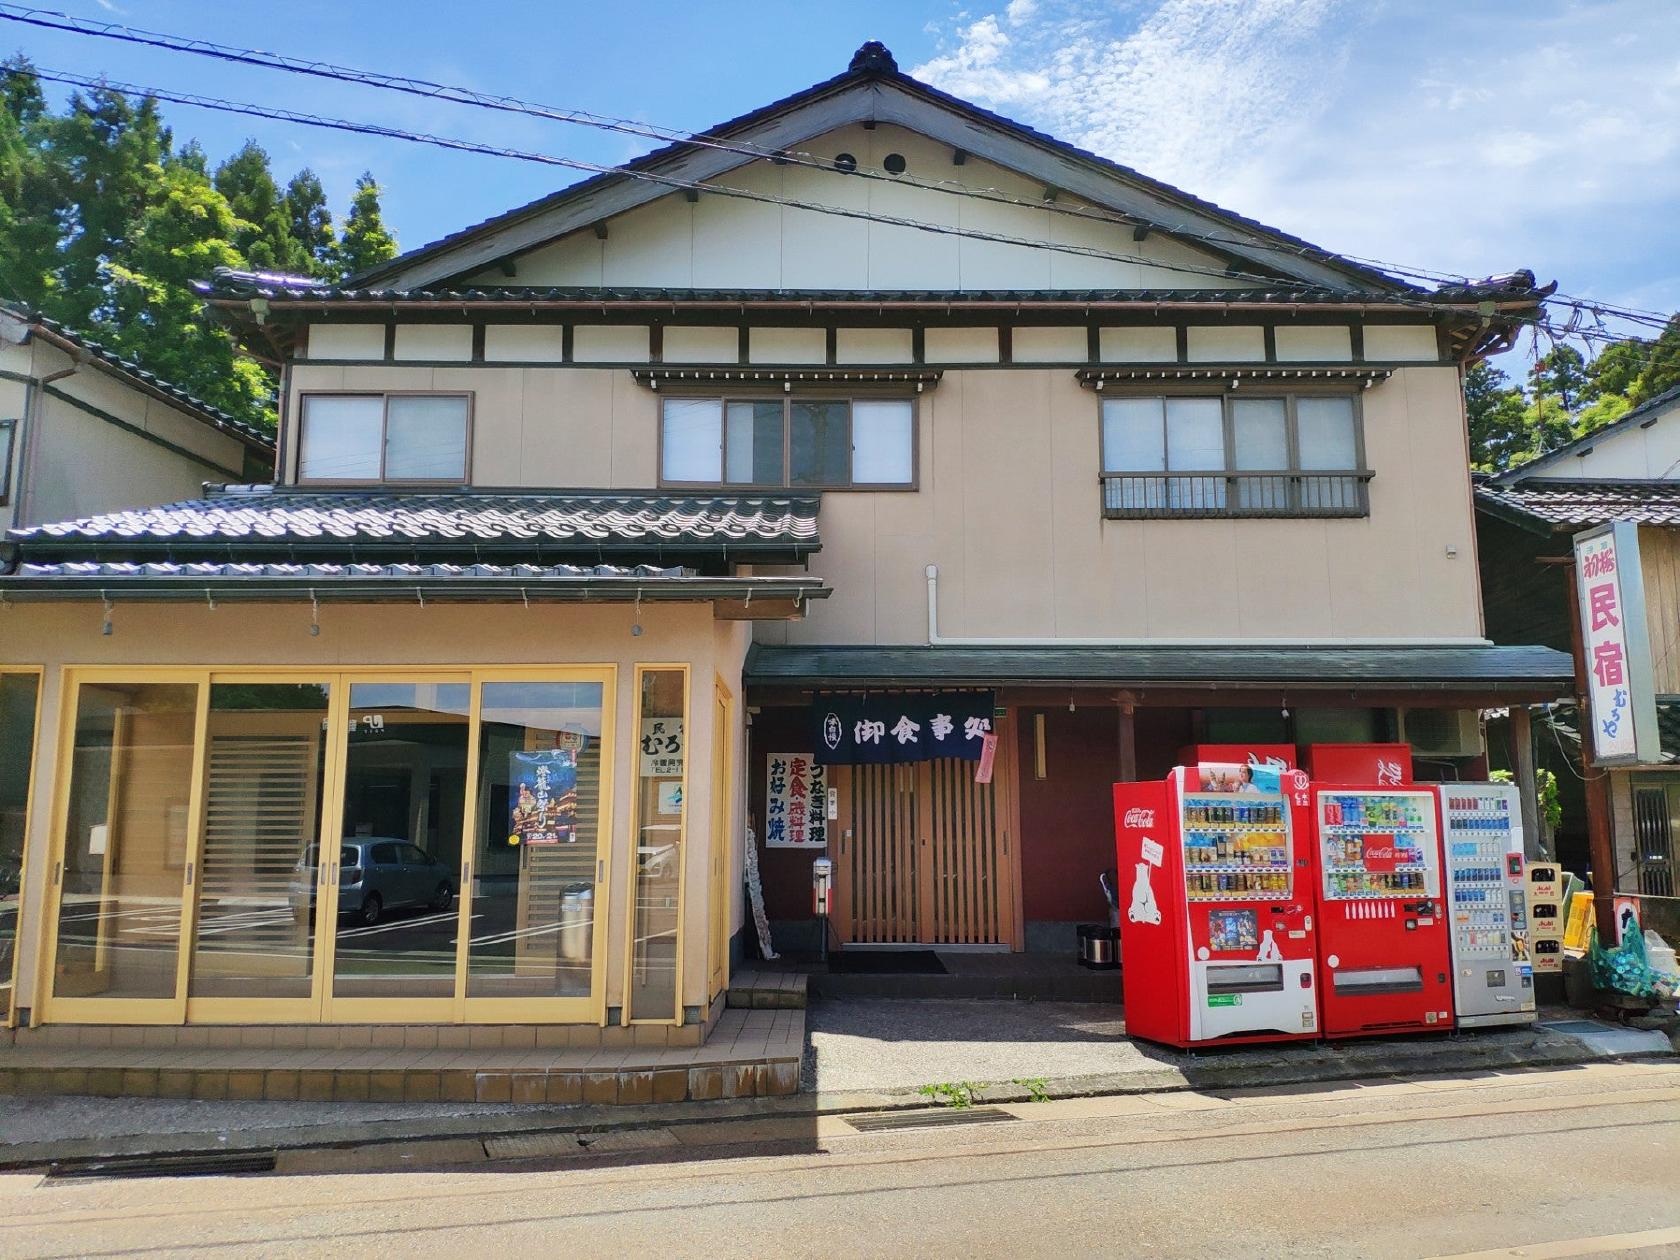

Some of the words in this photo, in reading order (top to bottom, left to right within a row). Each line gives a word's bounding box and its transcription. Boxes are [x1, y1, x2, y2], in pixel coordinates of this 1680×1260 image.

[1589, 582, 1623, 688] 民宿
[853, 713, 992, 746] 御食事処
[1602, 688, 1628, 739] むろや
[767, 758, 787, 841] お好み焼
